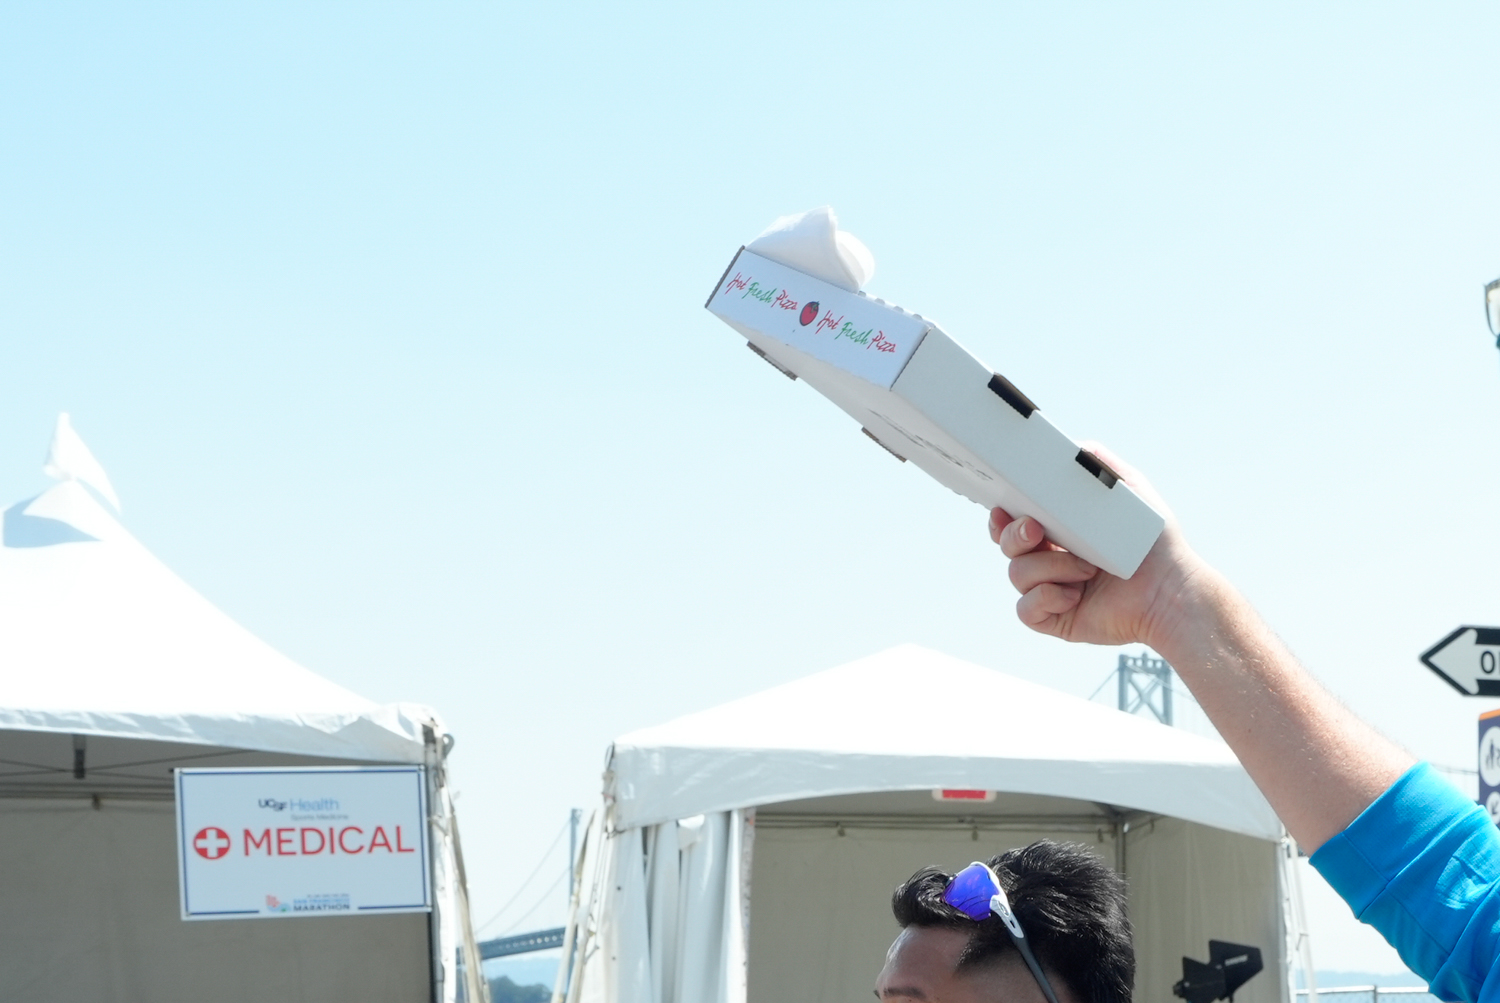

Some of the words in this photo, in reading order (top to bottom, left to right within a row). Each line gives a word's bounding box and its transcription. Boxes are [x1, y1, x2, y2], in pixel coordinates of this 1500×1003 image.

[726, 272, 751, 295] Hot
[743, 282, 777, 304] Fresh
[772, 290, 797, 310] Pizza
[816, 310, 843, 334] Hot
[836, 322, 873, 345] Fresh
[868, 331, 896, 353] Pizza
[290, 797, 340, 812] Health
[243, 825, 415, 857] MEDICAL
